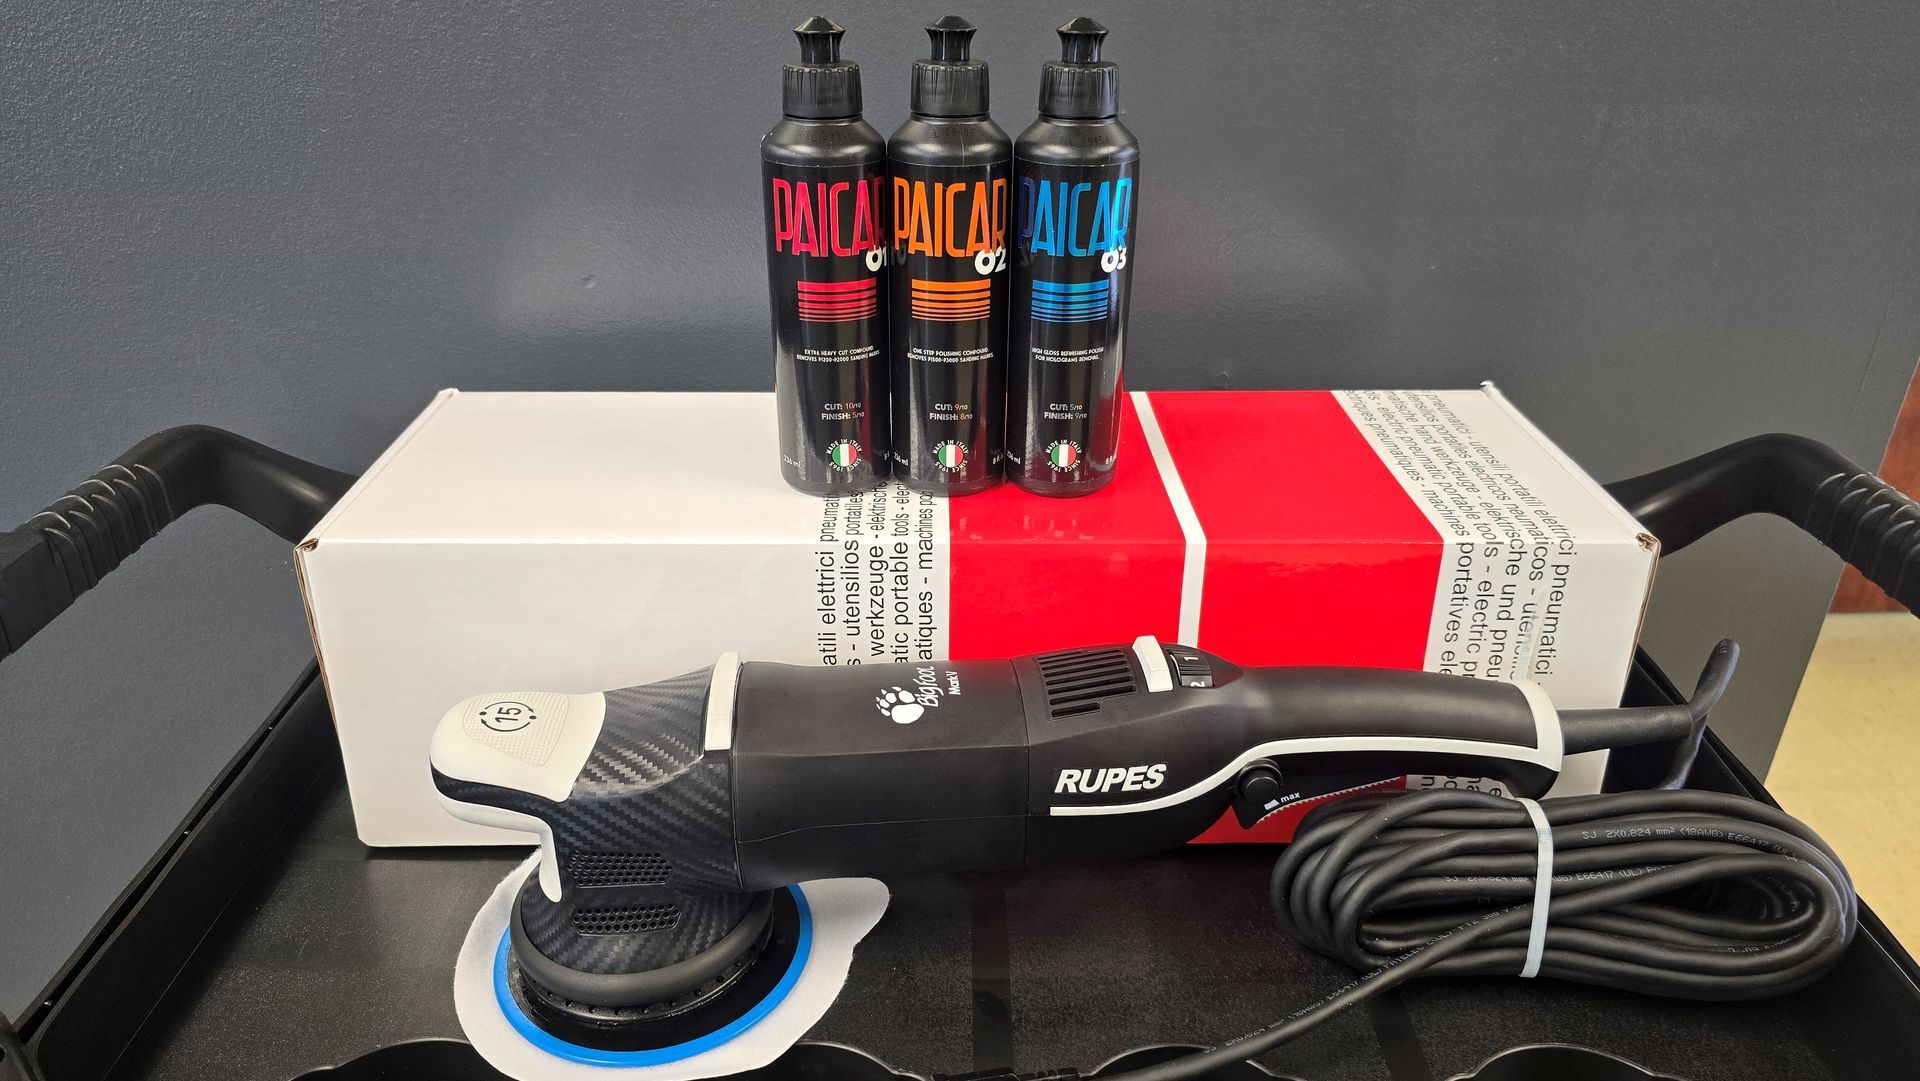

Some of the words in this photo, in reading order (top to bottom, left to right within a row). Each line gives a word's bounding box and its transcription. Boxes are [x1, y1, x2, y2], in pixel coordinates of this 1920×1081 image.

[894, 176, 1007, 257] PAICAR
[1018, 176, 1132, 257] PAICAR
[796, 354, 818, 362] REMOVES
[850, 353, 868, 361] SANDING
[849, 345, 874, 355] COMPOUND
[907, 352, 927, 361] REMOVES
[980, 352, 994, 360] MARKS
[962, 347, 989, 356] COMPOUND
[1088, 346, 1104, 354] POLISH
[821, 412, 851, 420] FINISH:
[852, 411, 865, 419] 5/10
[845, 402, 862, 410] 10/10
[929, 412, 959, 420] FINISH:
[960, 412, 974, 420] 8/10
[1044, 411, 1074, 420] FINISH:
[1377, 407, 1409, 435] electric
[1421, 394, 1472, 435] pneumatici
[826, 440, 840, 455] MADE
[849, 439, 863, 452] ITALY
[932, 440, 946, 455] MADE
[956, 440, 969, 454] ITALY
[1045, 440, 1059, 454] MADE
[1069, 440, 1082, 454] ITALY
[1410, 425, 1442, 444] hand
[845, 457, 862, 472] SINCE
[952, 459, 968, 473] SINCE
[1064, 459, 1081, 473] SINCE
[1364, 423, 1425, 481] pneumatiques
[1395, 436, 1447, 480] pneumatic
[1469, 440, 1511, 473] utensili
[1430, 446, 1480, 493] werkzeuge
[866, 481, 888, 531] elektrische
[1428, 424, 1470, 460] portatiles
[1465, 460, 1511, 501] electricos
[1503, 503, 1554, 581] neumaticos
[1433, 482, 1481, 520] portable
[1494, 473, 1546, 507] portatili
[890, 513, 910, 537] tools
[1421, 489, 1471, 537] machines
[914, 508, 934, 570] machines
[1473, 522, 1505, 558] tools
[1480, 502, 1528, 576] elektrische
[1534, 509, 1577, 556] elettrici
[815, 551, 836, 625] elettrici
[840, 540, 861, 636] utensilios
[889, 541, 914, 625] portable
[1443, 541, 1475, 643] portatives
[866, 545, 889, 657] werkzeuge
[1465, 580, 1495, 654] electric
[1496, 584, 1517, 621] und
[1534, 564, 1570, 676] pneumatici
[913, 665, 945, 707] Bigfoot
[946, 675, 961, 696] Mark
[494, 707, 522, 723] 15
[1054, 763, 1168, 794] RUPES
[1280, 791, 1301, 804] max
[1581, 830, 1598, 840] SJ
[1680, 826, 1724, 838] (18AWG)
[1727, 832, 1770, 848] E66417
[1576, 870, 1615, 881] E66417
[1619, 868, 1643, 878] (UL)
